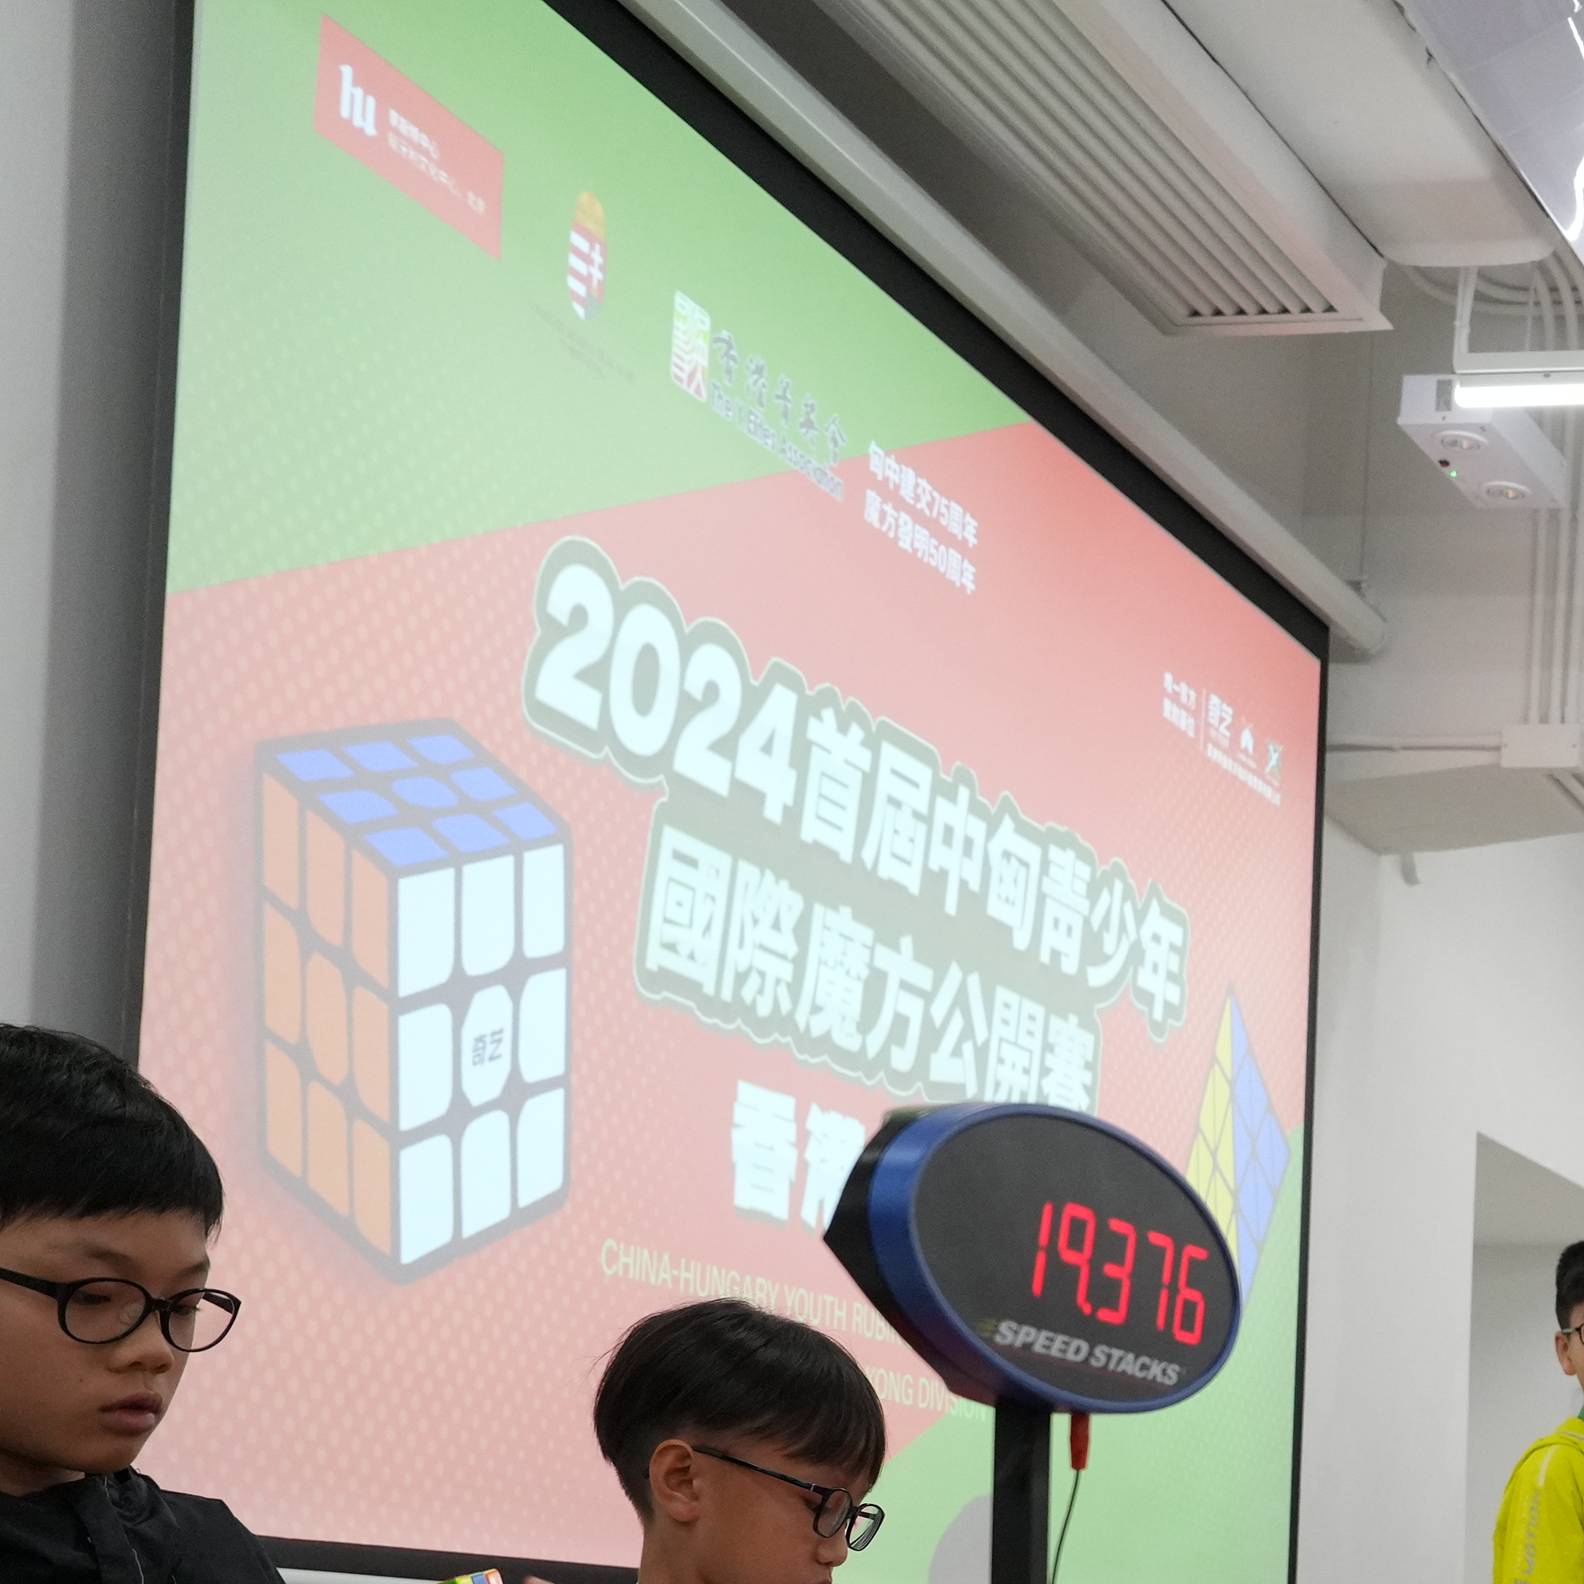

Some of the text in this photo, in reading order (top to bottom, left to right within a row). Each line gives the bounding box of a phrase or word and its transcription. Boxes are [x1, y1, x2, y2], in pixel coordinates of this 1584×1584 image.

[535, 564, 1183, 1022] 2024首屆中匈青少年
[645, 825, 1095, 1114] 國際魔方公開賽
[601, 1239, 779, 1311] CHINA-HUNGARY
[783, 1285, 847, 1331] YOUTH
[994, 1320, 1181, 1386] SPEED STACKS
